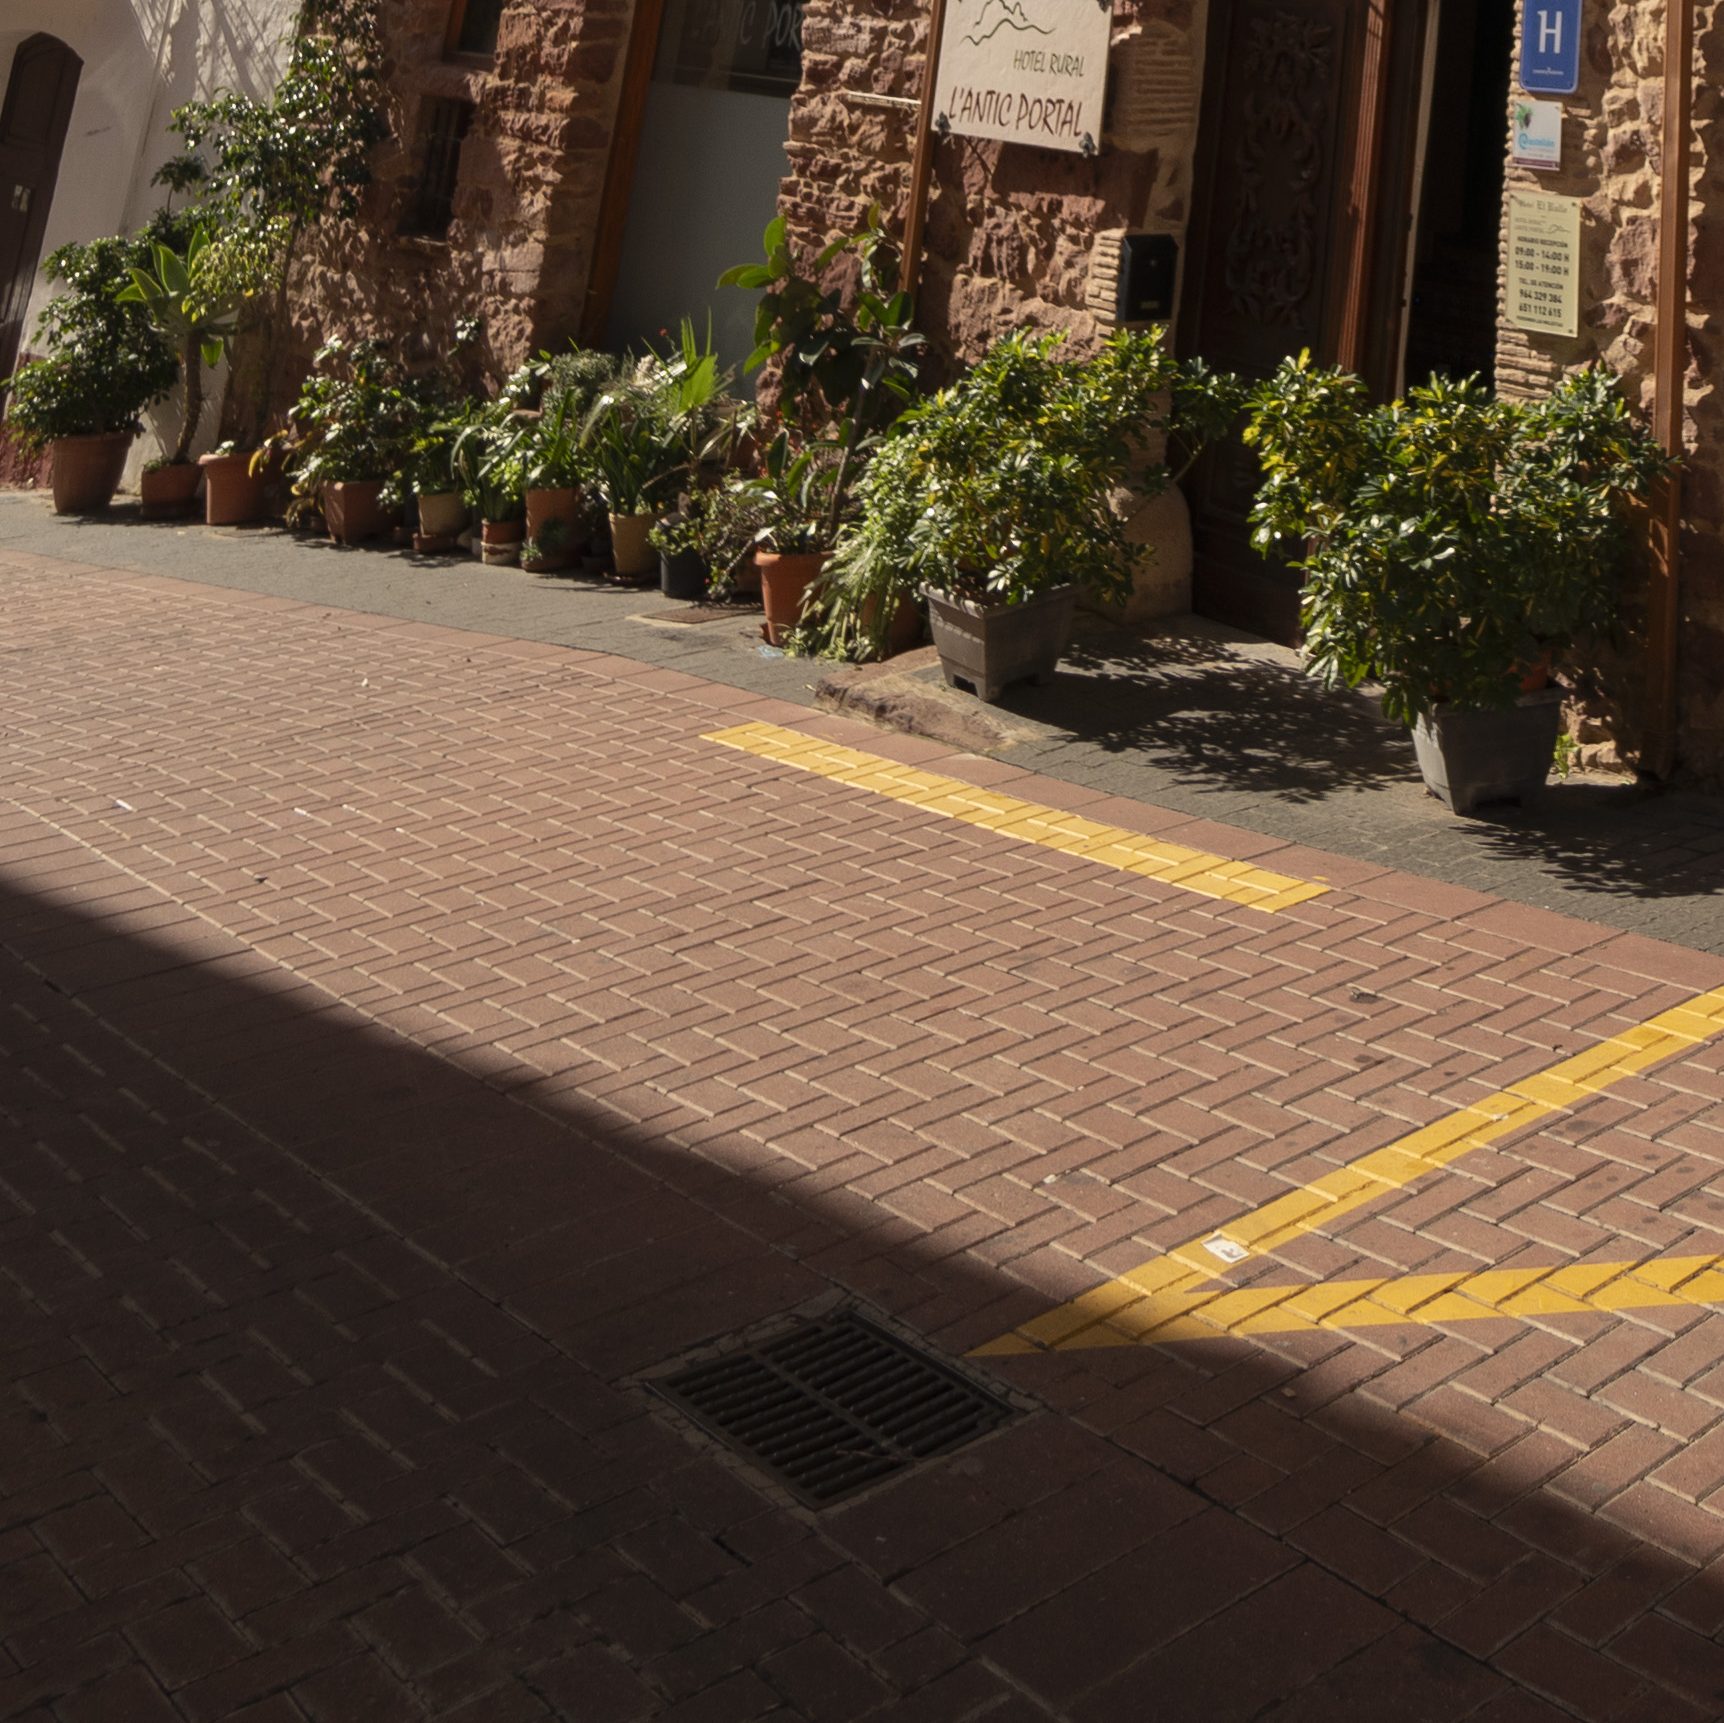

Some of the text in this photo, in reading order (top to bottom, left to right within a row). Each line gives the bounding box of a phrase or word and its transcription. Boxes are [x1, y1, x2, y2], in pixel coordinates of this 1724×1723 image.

[761, 0, 804, 51] POR
[1537, 10, 1563, 54] H
[1014, 49, 1085, 77] HOTEL RURAL
[948, 86, 1082, 138] L'ANTIC PORTAL
[1563, 267, 1569, 276] H
[1564, 253, 1569, 262] H
[1534, 305, 1547, 316] 112
